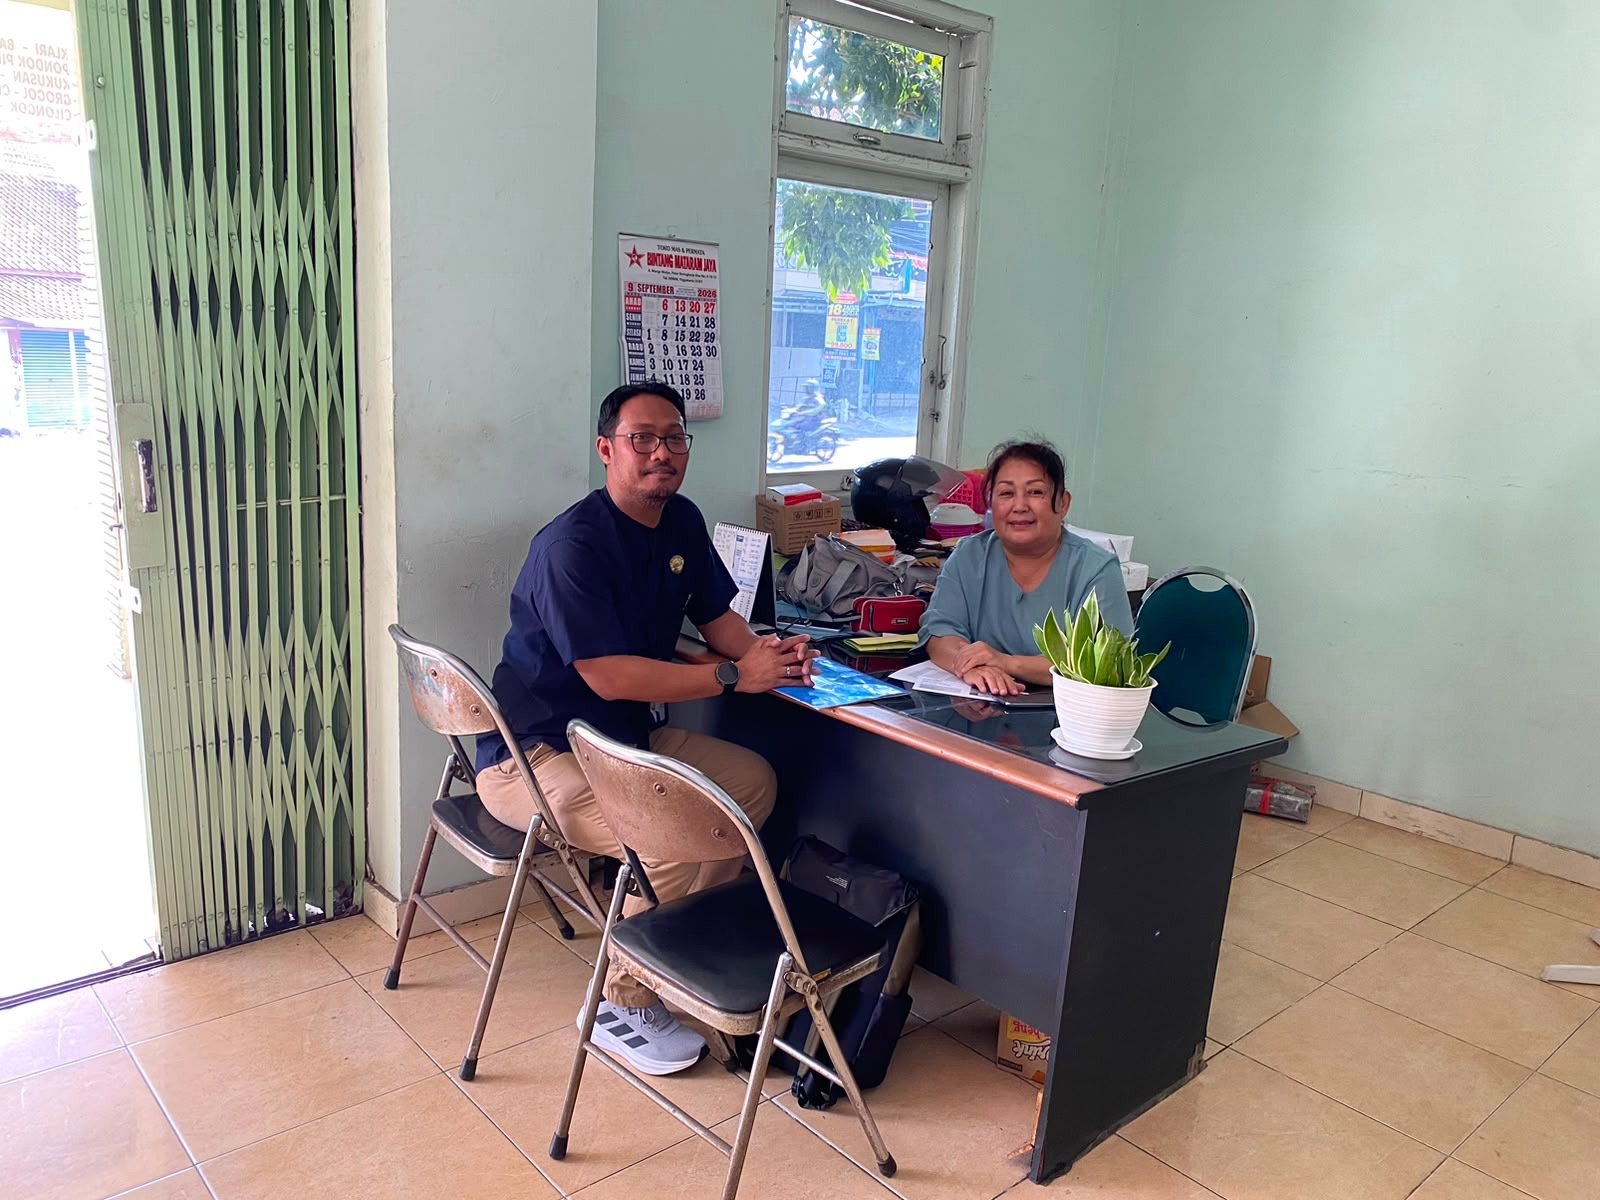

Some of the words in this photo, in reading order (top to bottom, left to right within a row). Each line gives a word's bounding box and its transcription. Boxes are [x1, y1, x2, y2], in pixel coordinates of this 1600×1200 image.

[647, 252, 673, 268] BINTANG
[674, 255, 702, 271] MATARAM
[703, 258, 717, 272] JAYA
[627, 282, 634, 292] 9
[637, 283, 675, 295] SEPTEMBER
[697, 289, 717, 298] 2026
[662, 299, 668, 311] 6
[675, 299, 686, 312] 13
[689, 301, 701, 313] 20
[704, 302, 716, 314] 27
[662, 314, 668, 326] 7
[675, 314, 686, 328] 14
[689, 315, 700, 328] 21
[704, 316, 716, 329] 28
[647, 328, 652, 340] 1
[661, 329, 668, 341] 8
[675, 330, 686, 342] 15
[689, 331, 701, 343] 22
[704, 331, 716, 344] 29
[648, 342, 655, 355] 2
[662, 344, 669, 356] 9
[676, 344, 687, 356] 16
[690, 345, 702, 357] 23
[705, 345, 717, 357] 30
[649, 357, 656, 370] 3
[662, 358, 674, 371] 10
[678, 359, 689, 371] 17
[692, 360, 704, 372] 24
[664, 373, 675, 385] 11
[679, 374, 690, 386] 18
[693, 374, 705, 386] 25
[694, 388, 706, 401] 26
